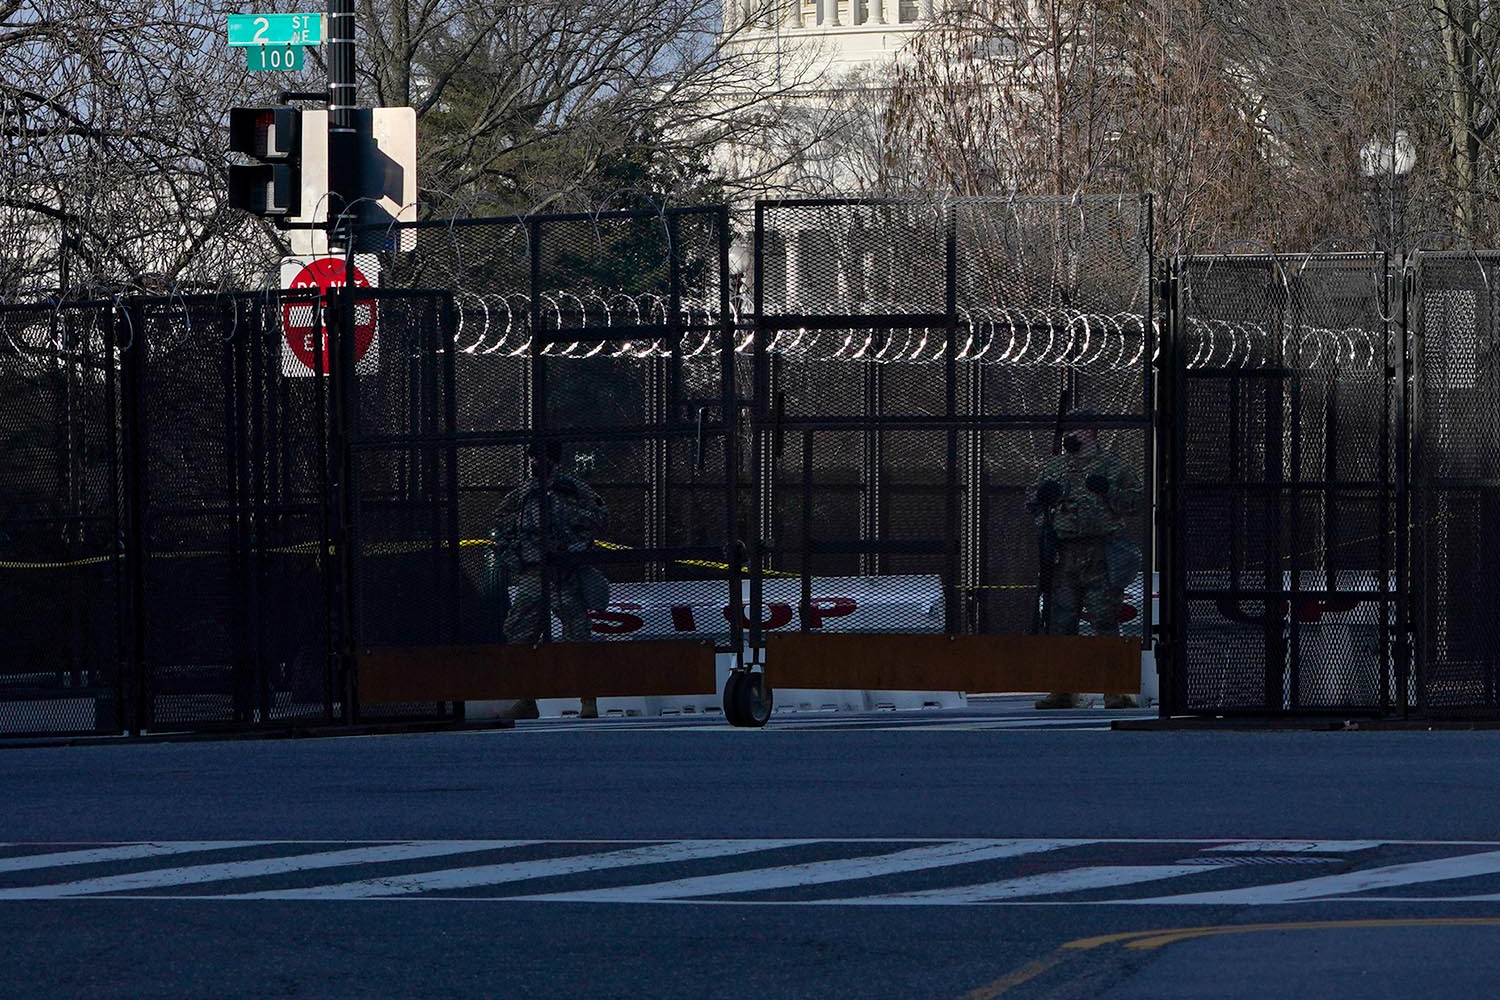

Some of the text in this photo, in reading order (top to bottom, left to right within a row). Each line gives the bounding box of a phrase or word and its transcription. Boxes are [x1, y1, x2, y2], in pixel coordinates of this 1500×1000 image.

[252, 16, 310, 42] 2 ST
[291, 30, 310, 42] NE
[260, 50, 295, 68] 100
[586, 597, 857, 634] STOP
